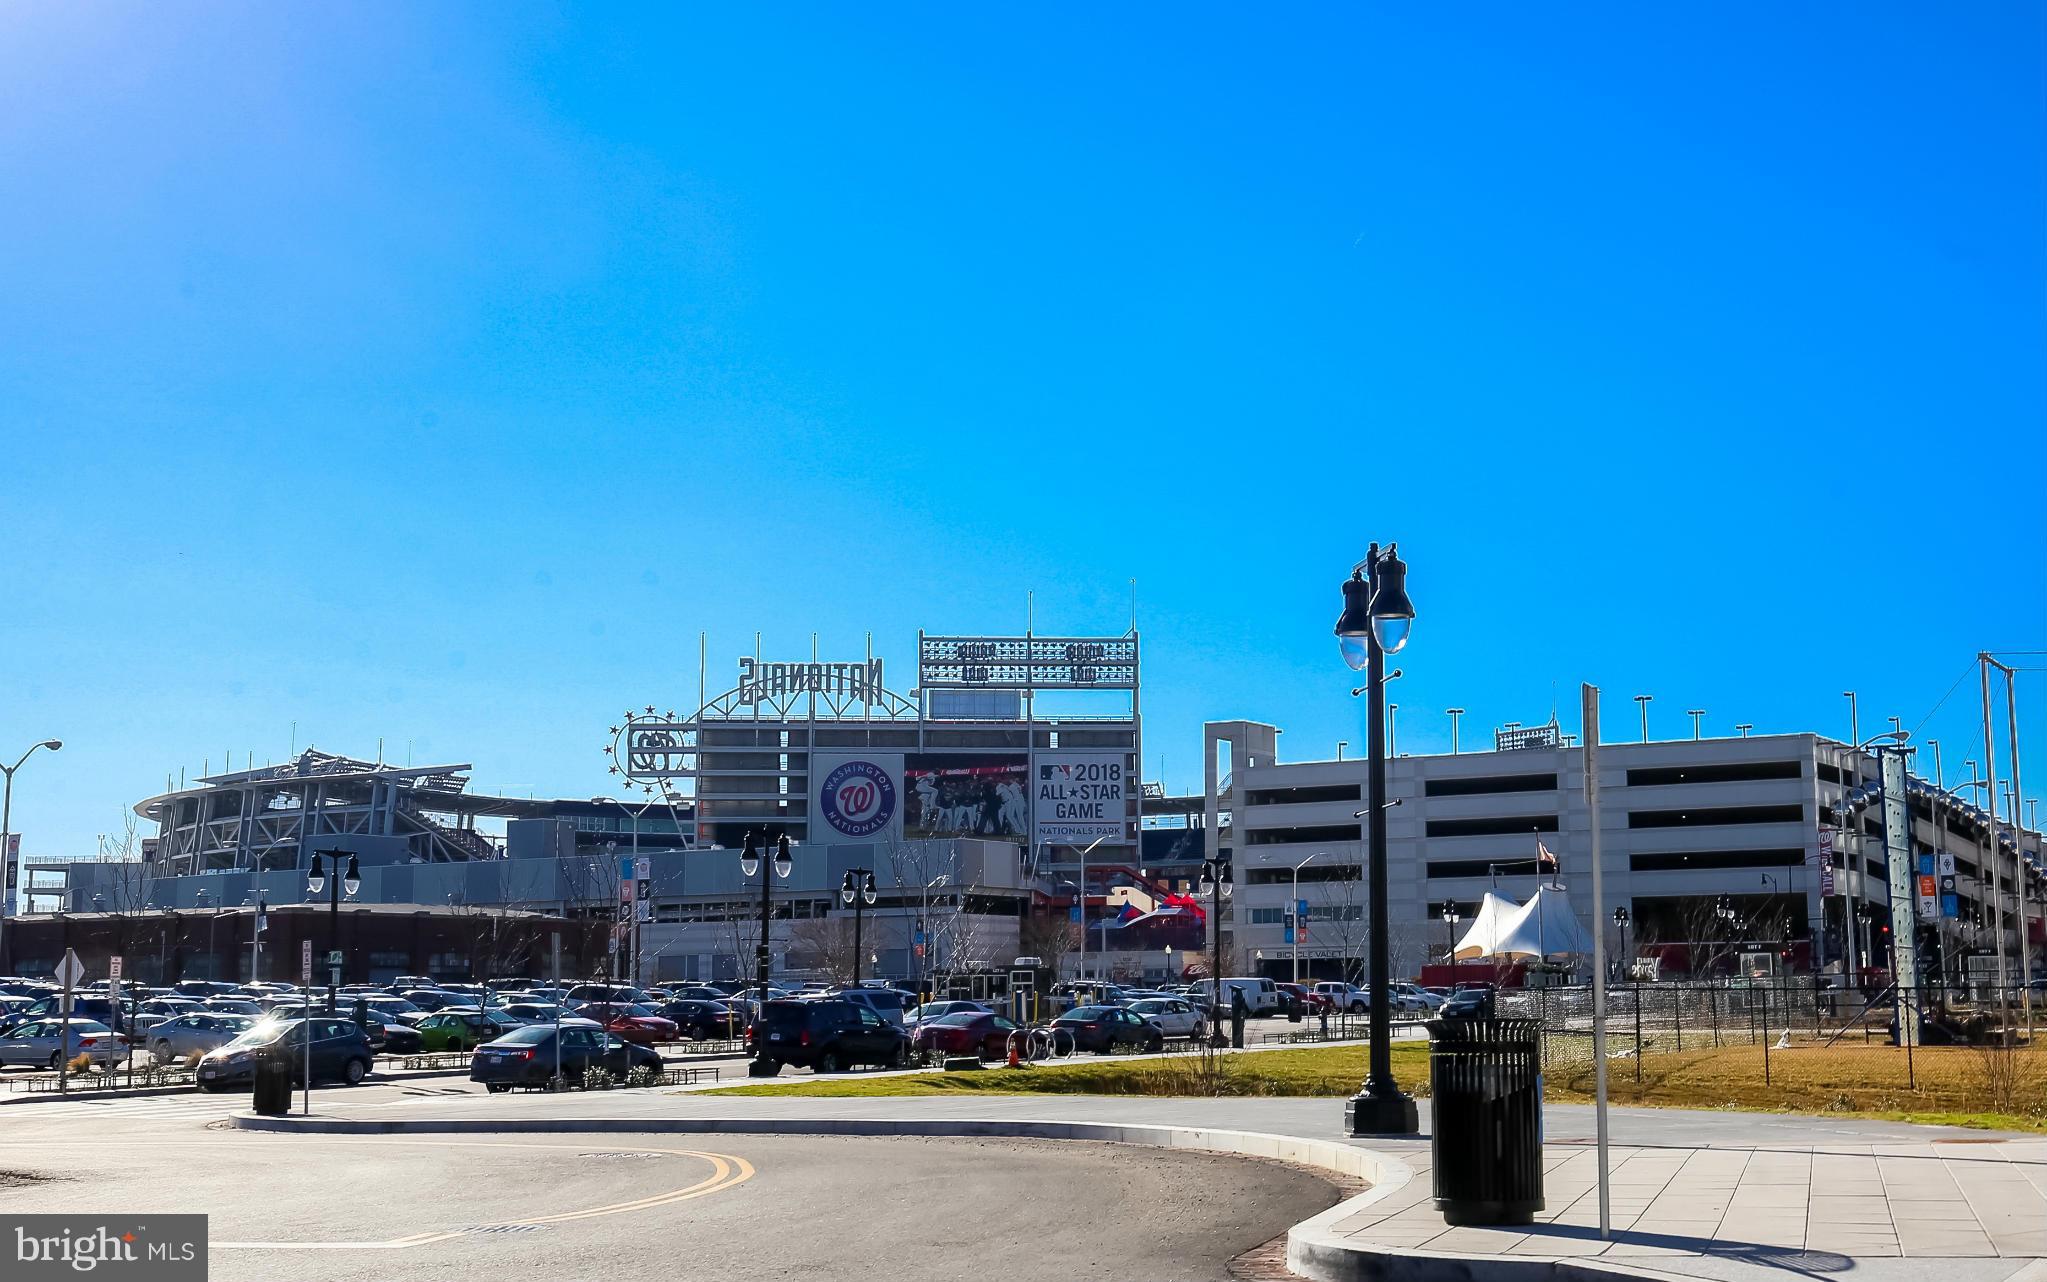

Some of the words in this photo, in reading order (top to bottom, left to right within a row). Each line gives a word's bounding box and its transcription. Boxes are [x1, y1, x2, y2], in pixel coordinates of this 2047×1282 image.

[826, 764, 891, 792] WASHINGTON
[1074, 763, 1121, 782] 2018
[1039, 784, 1067, 800] ALL
[1080, 784, 1121, 800] STAR
[1056, 802, 1104, 819] GAME
[828, 811, 888, 833] NATIONALS
[1039, 827, 1094, 835] NATIONALS
[1096, 827, 1121, 835] PARK
